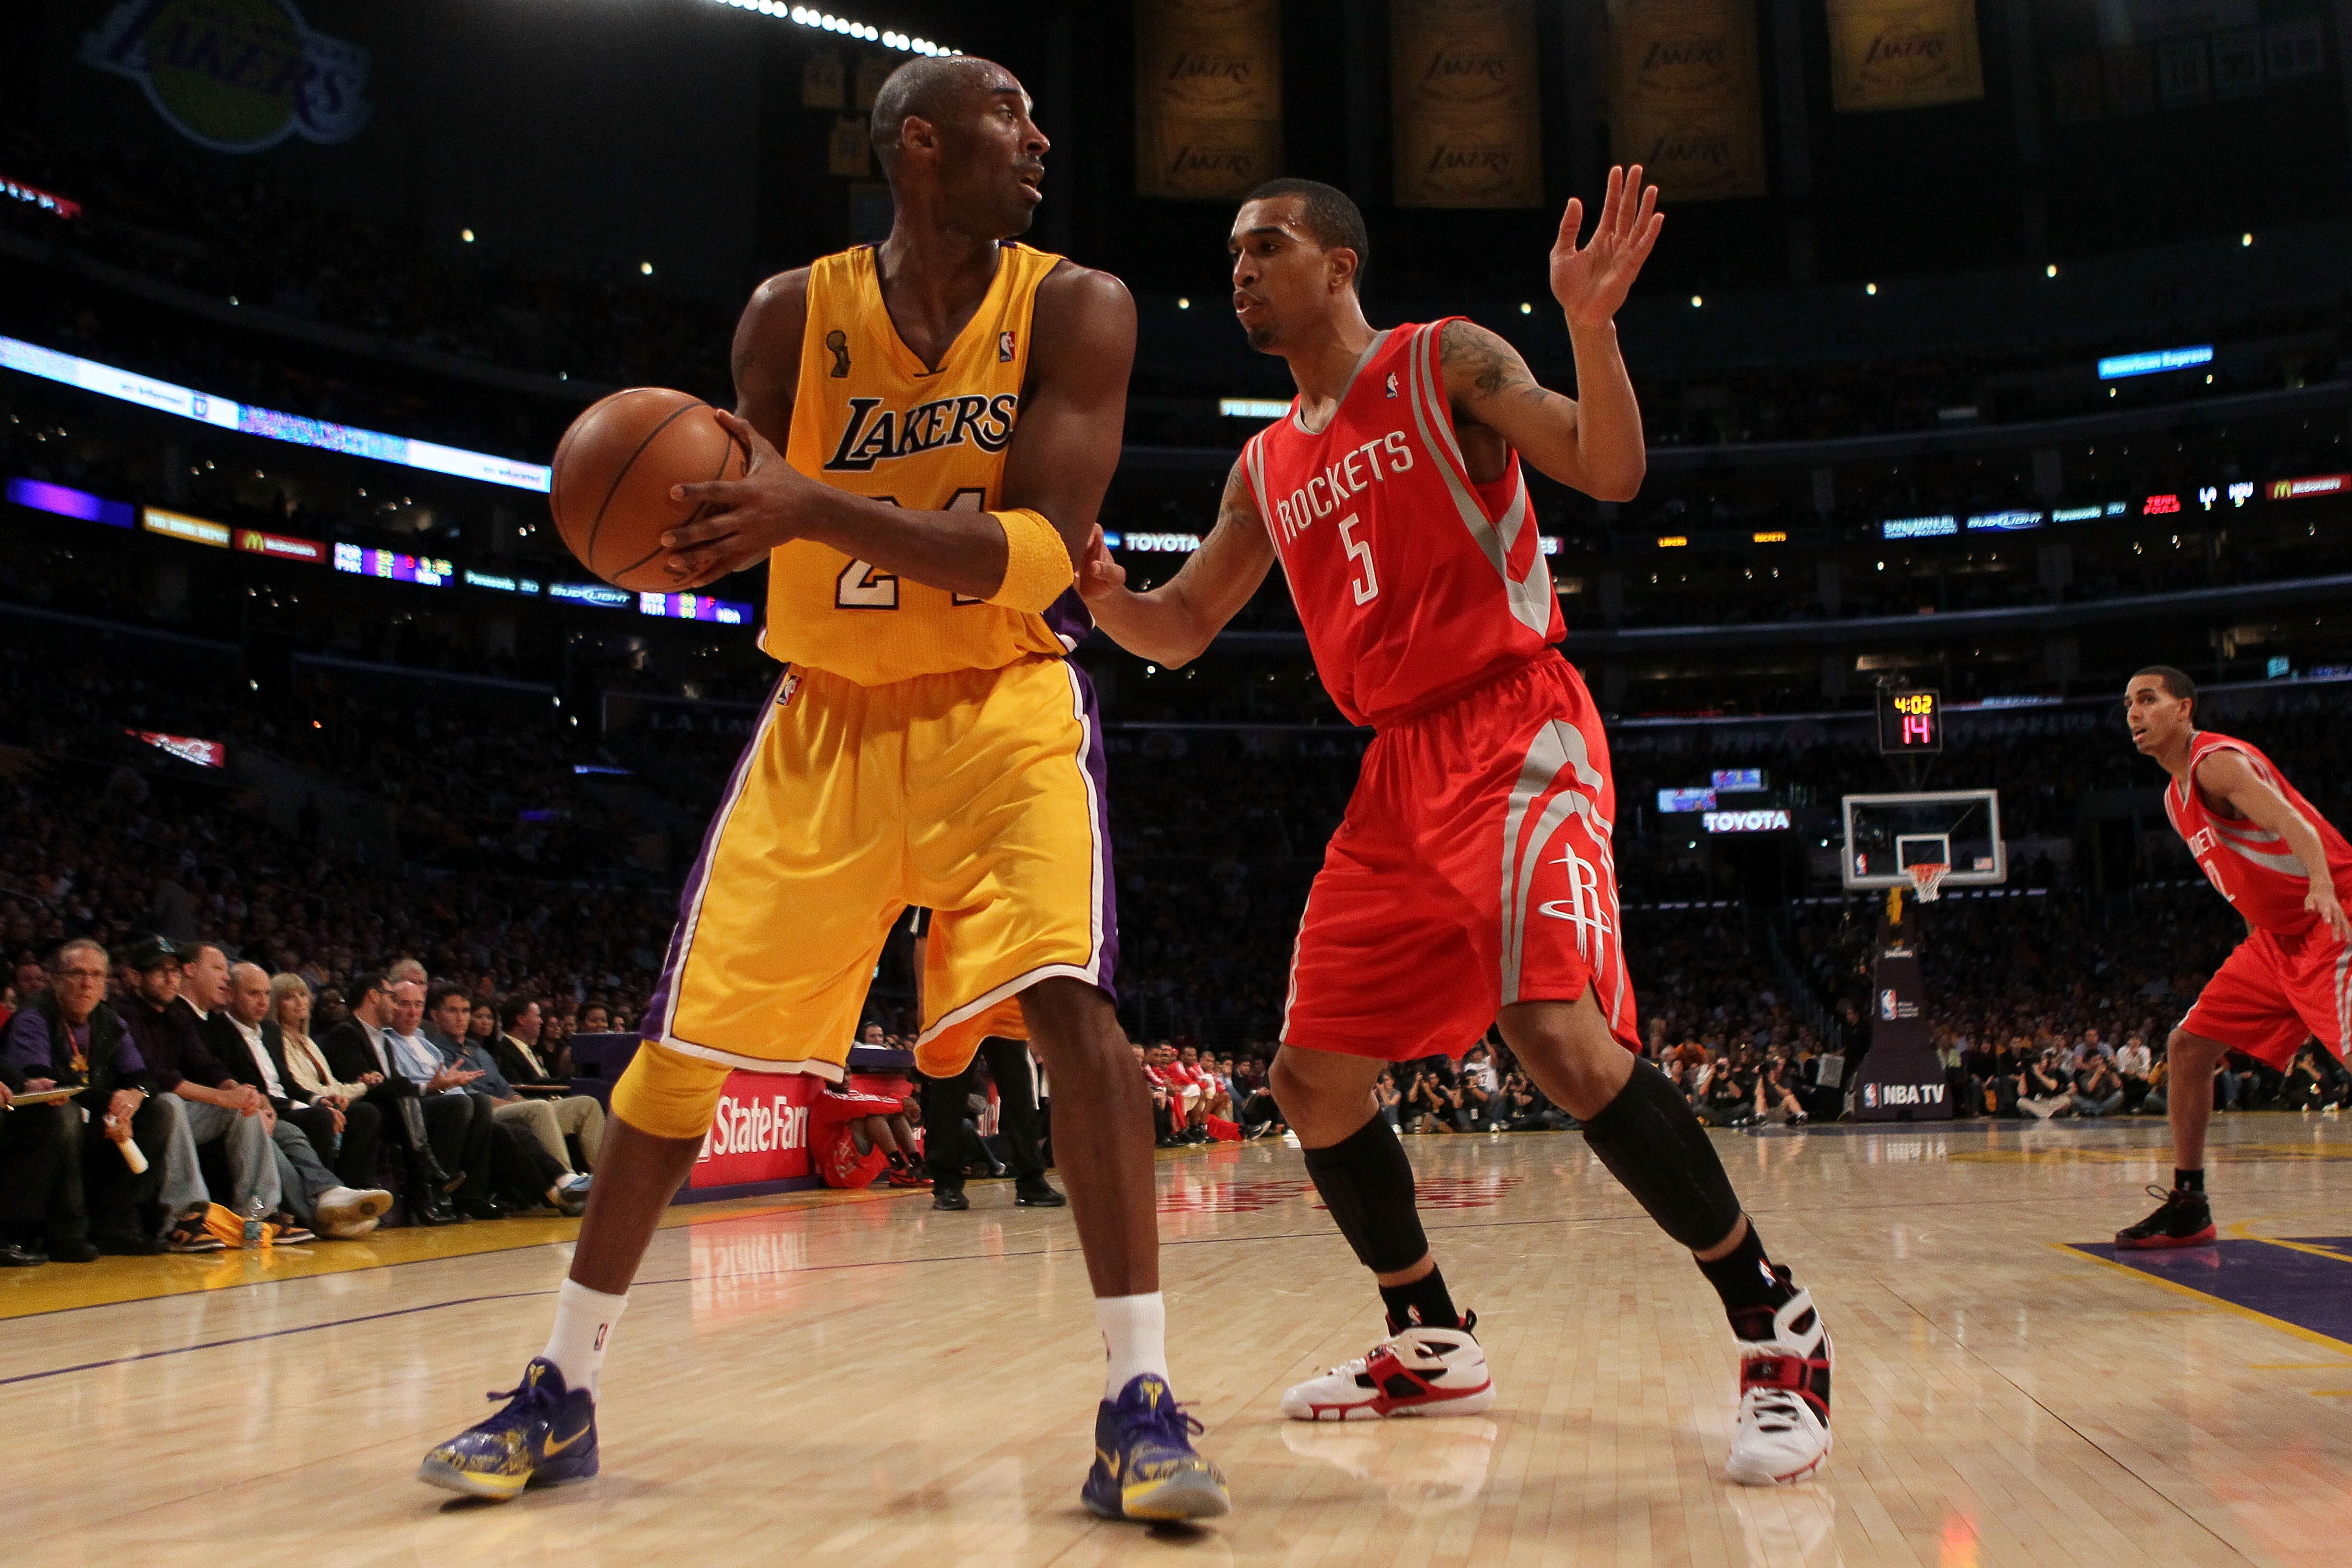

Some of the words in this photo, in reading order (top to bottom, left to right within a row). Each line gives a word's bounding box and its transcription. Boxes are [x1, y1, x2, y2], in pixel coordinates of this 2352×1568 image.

[822, 392, 1018, 472] LAKERS
[1276, 430, 1414, 546] ROCKETS
[1967, 515, 1998, 529] BUD
[2003, 512, 2044, 526] LIGHT
[1124, 532, 1201, 552] TOYOTA
[1338, 512, 1379, 607] 5
[548, 582, 583, 598] BUD
[588, 590, 631, 603] LIGHT
[1894, 695, 1932, 715] 4:02
[1903, 715, 1930, 744] 14
[1703, 810, 1790, 832] TOYOTA
[1883, 1085, 1921, 1105] NBA
[1920, 1083, 1946, 1104] TV
